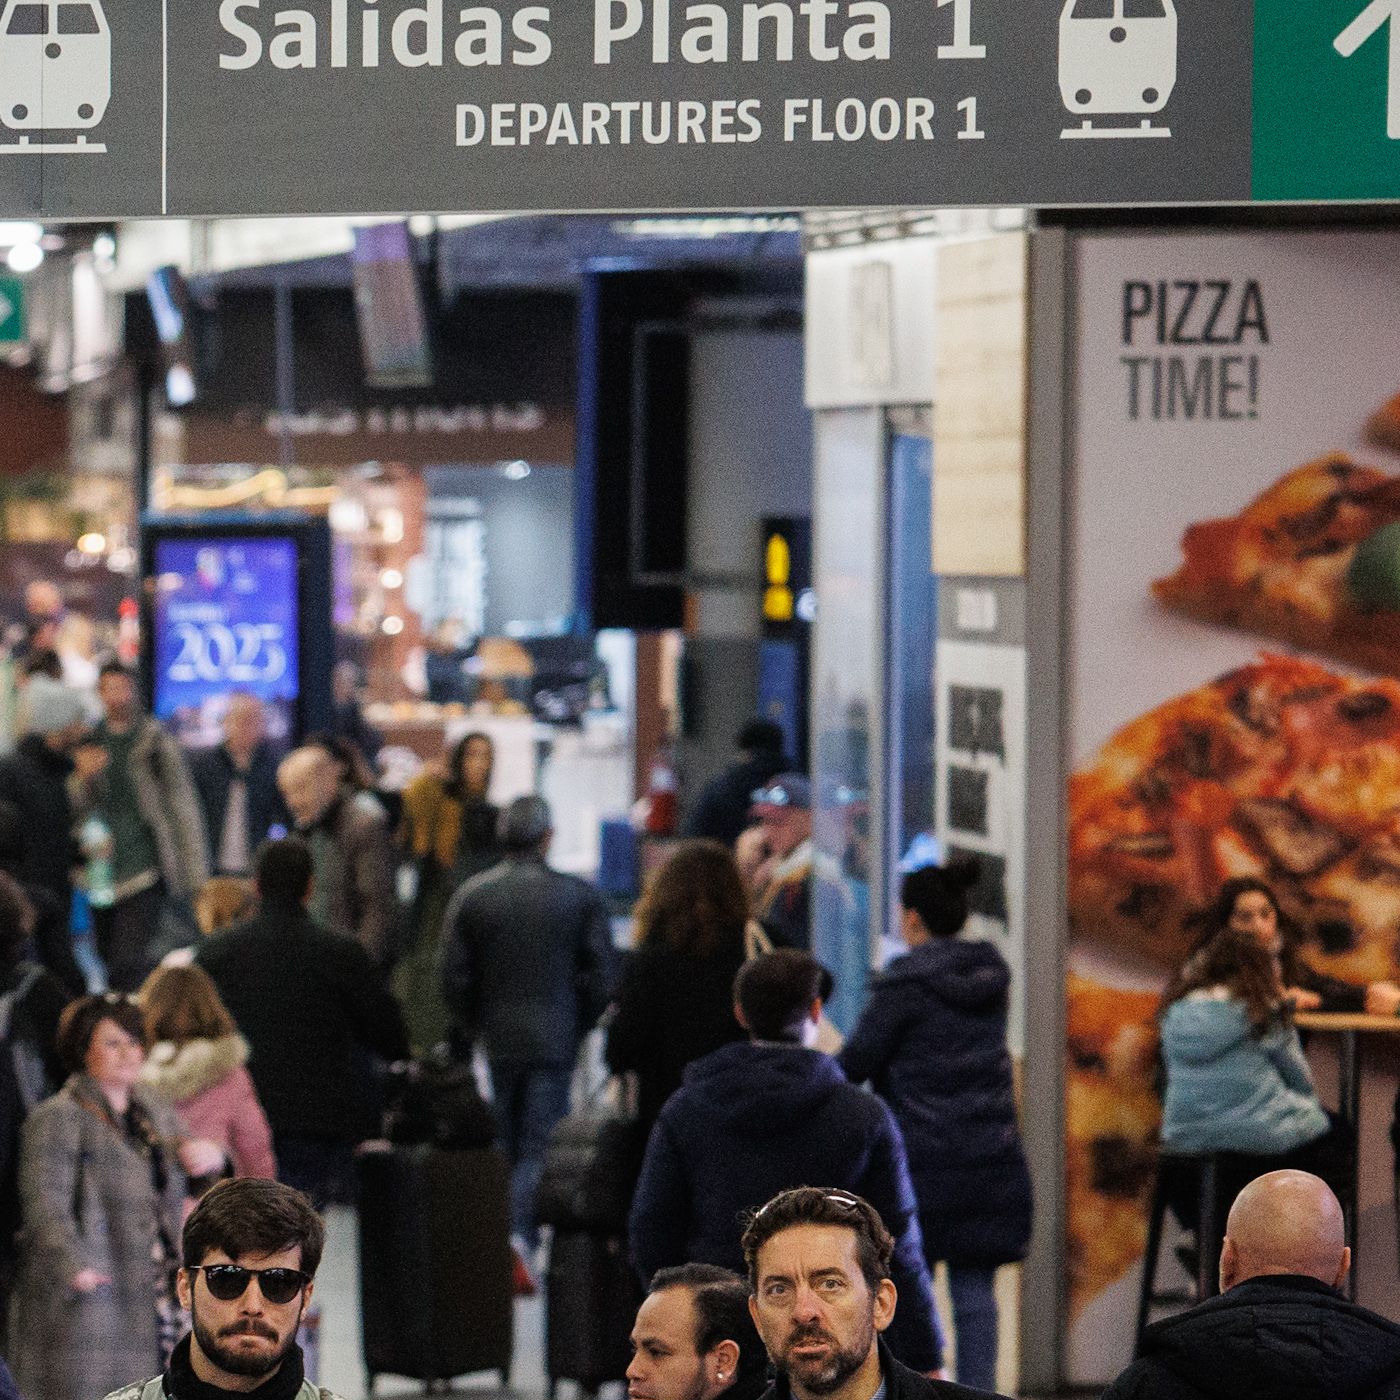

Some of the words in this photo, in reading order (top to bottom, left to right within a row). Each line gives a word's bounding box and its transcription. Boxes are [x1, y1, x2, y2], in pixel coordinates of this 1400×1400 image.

[219, 0, 551, 70] Salidas
[594, 0, 890, 64] Planta
[937, 0, 986, 59] 1
[456, 99, 761, 146] DEPARTURES
[784, 98, 934, 141] FLOOR
[957, 97, 984, 139] 1
[1122, 279, 1269, 345] PIZZA
[1119, 354, 1259, 422] TIME!
